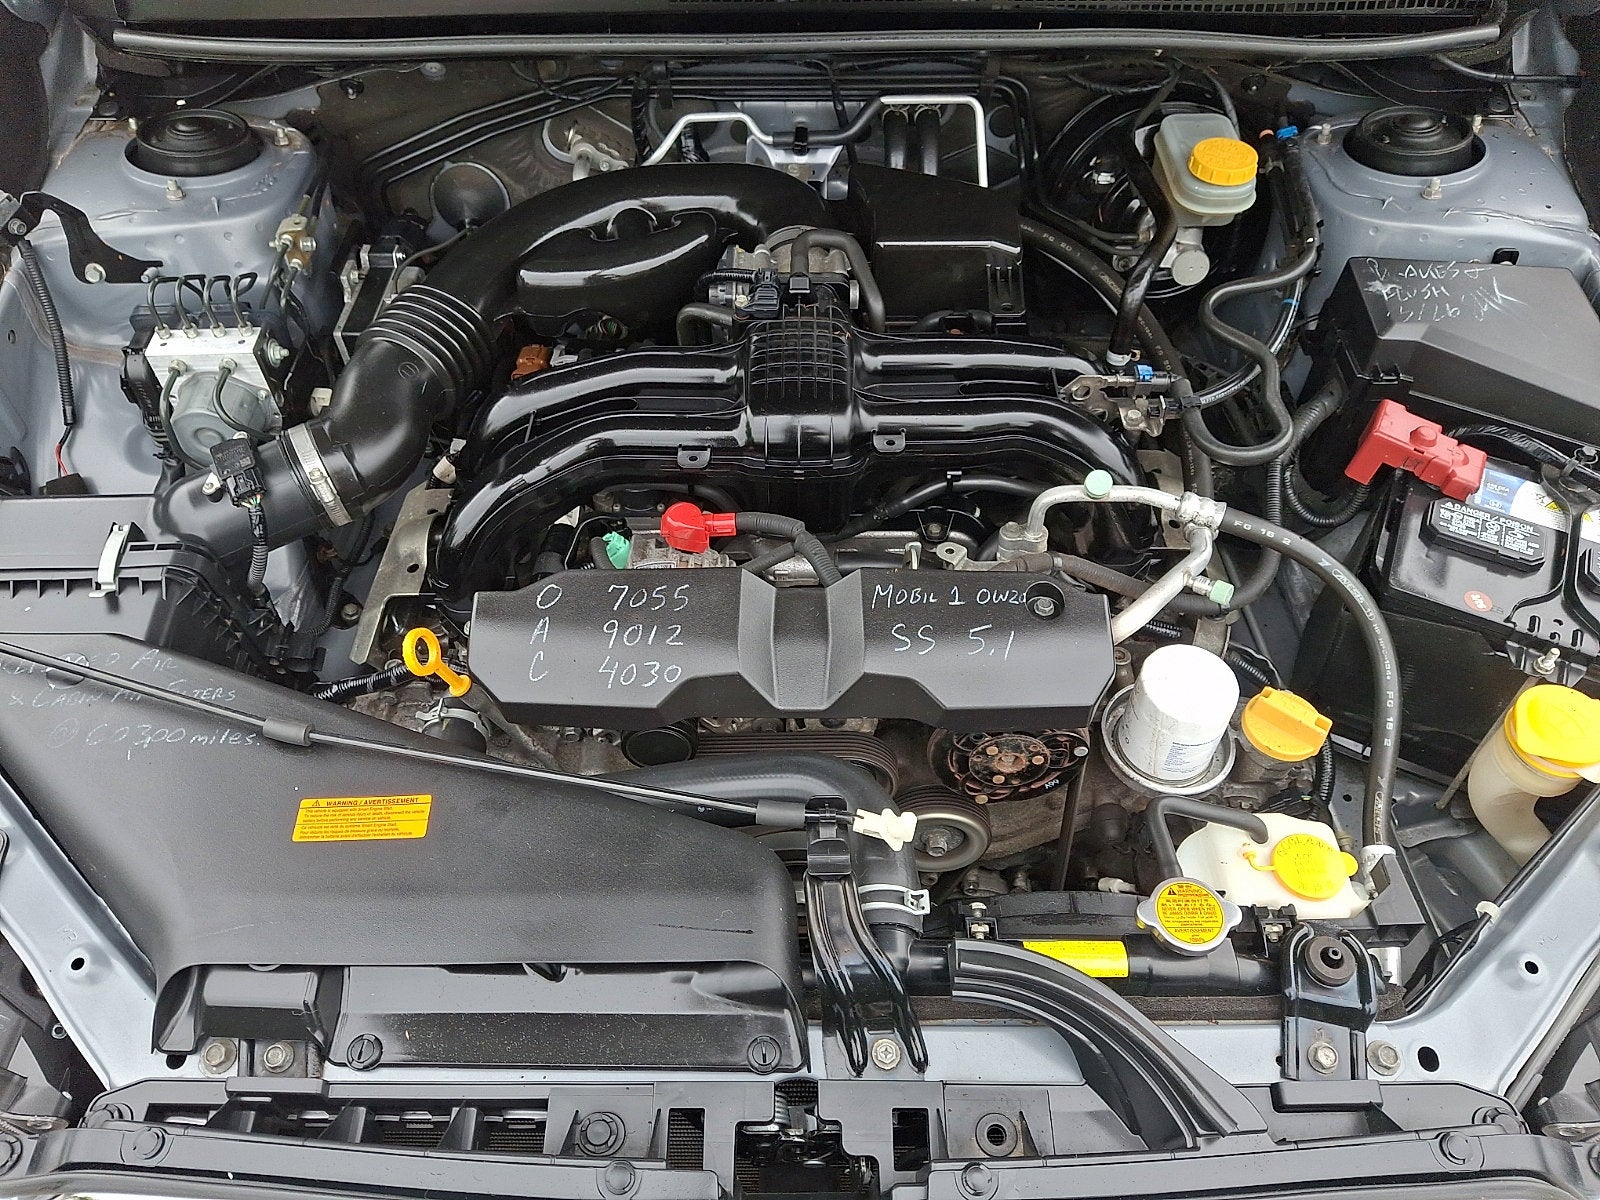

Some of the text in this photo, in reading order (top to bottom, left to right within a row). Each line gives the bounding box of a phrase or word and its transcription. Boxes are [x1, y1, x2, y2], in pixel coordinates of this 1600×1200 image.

[1234, 520, 1292, 546] FG 16 2
[607, 583, 690, 612] 7055
[948, 585, 966, 606] 1
[529, 616, 684, 649] A 9012
[891, 622, 936, 655] SS
[529, 650, 682, 689] C 4030
[1386, 691, 1394, 708] FG
[1383, 738, 1392, 747] 2
